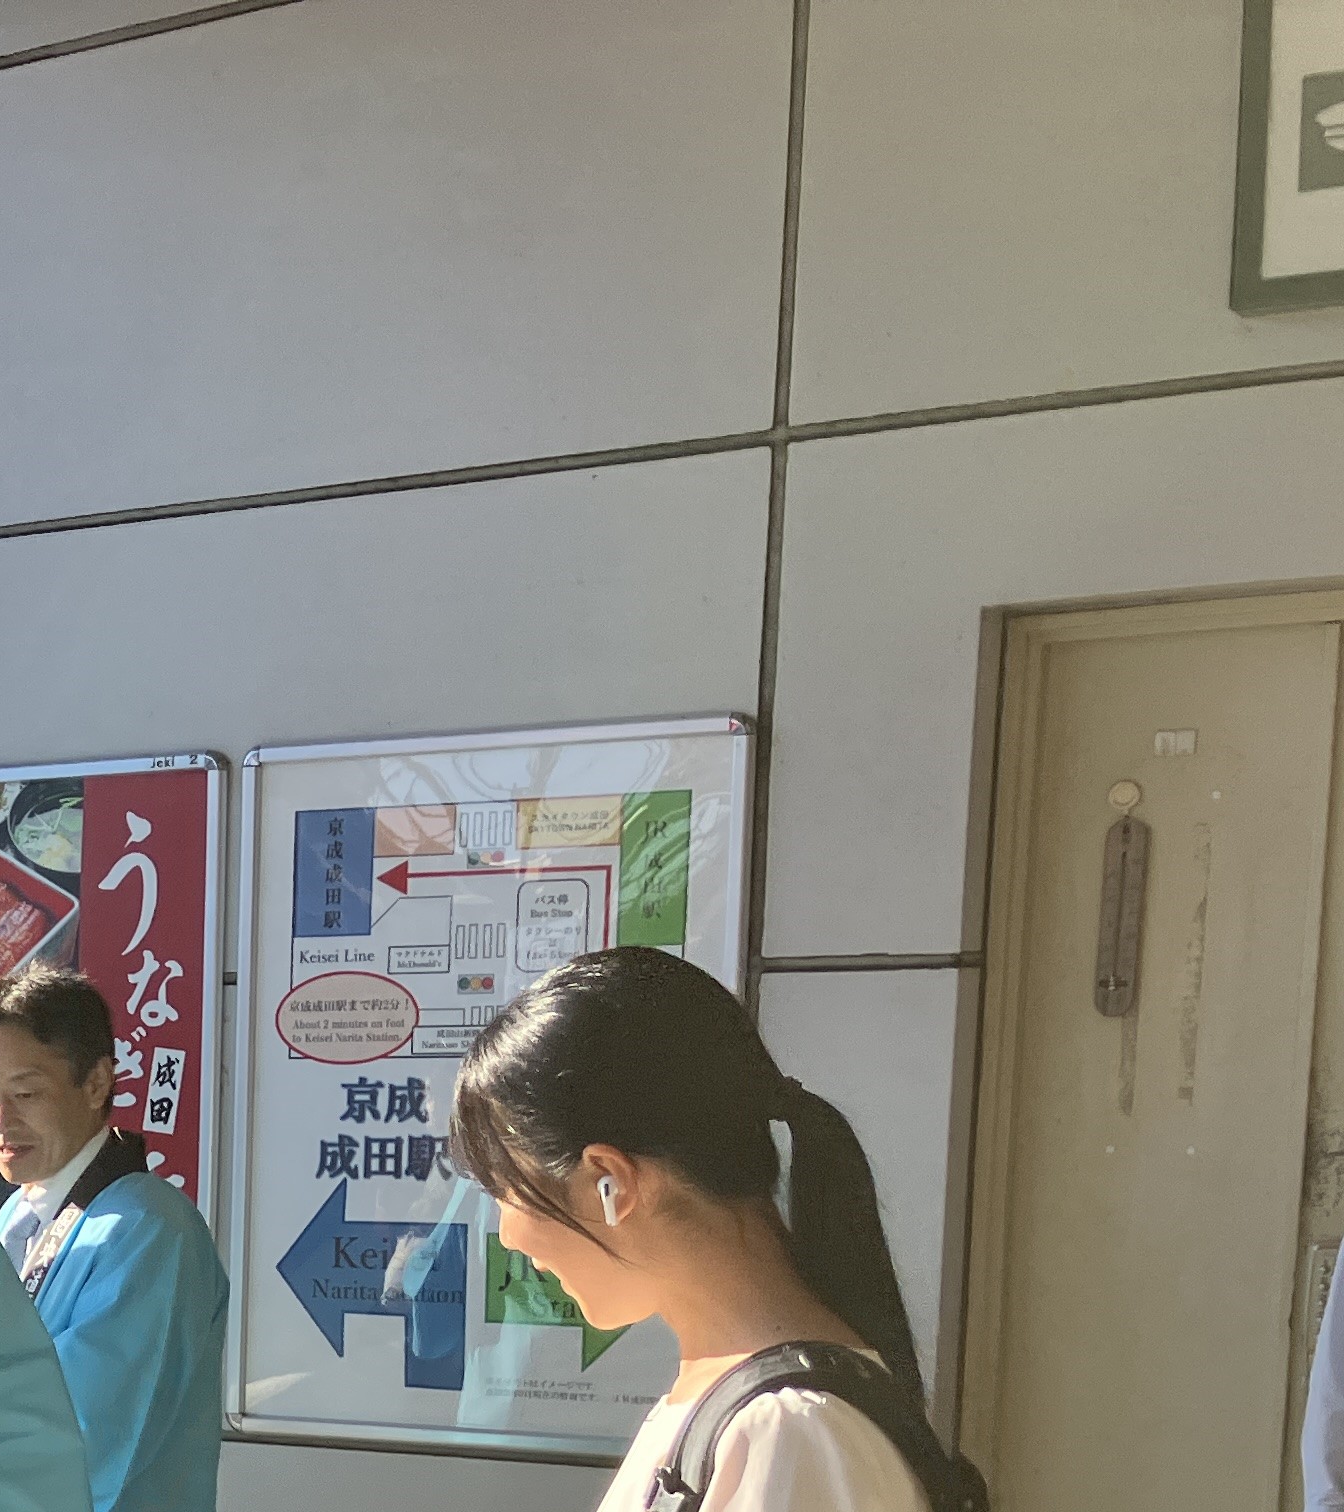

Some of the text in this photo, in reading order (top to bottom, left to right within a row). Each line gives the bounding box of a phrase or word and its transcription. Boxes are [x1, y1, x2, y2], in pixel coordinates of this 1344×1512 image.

[189, 754, 198, 765] 2
[323, 817, 344, 929] 京成成田駅
[530, 909, 573, 918] Bus Stop
[299, 948, 375, 964] Keisei Line
[292, 1018, 405, 1029] About 2 minutes on foot
[292, 1034, 302, 1043] to
[305, 1033, 333, 1043] Keisei
[335, 1033, 363, 1042] Narita
[340, 1076, 429, 1124] 京成
[315, 1134, 455, 1182] 成田駅
[312, 1278, 376, 1299] Narita
